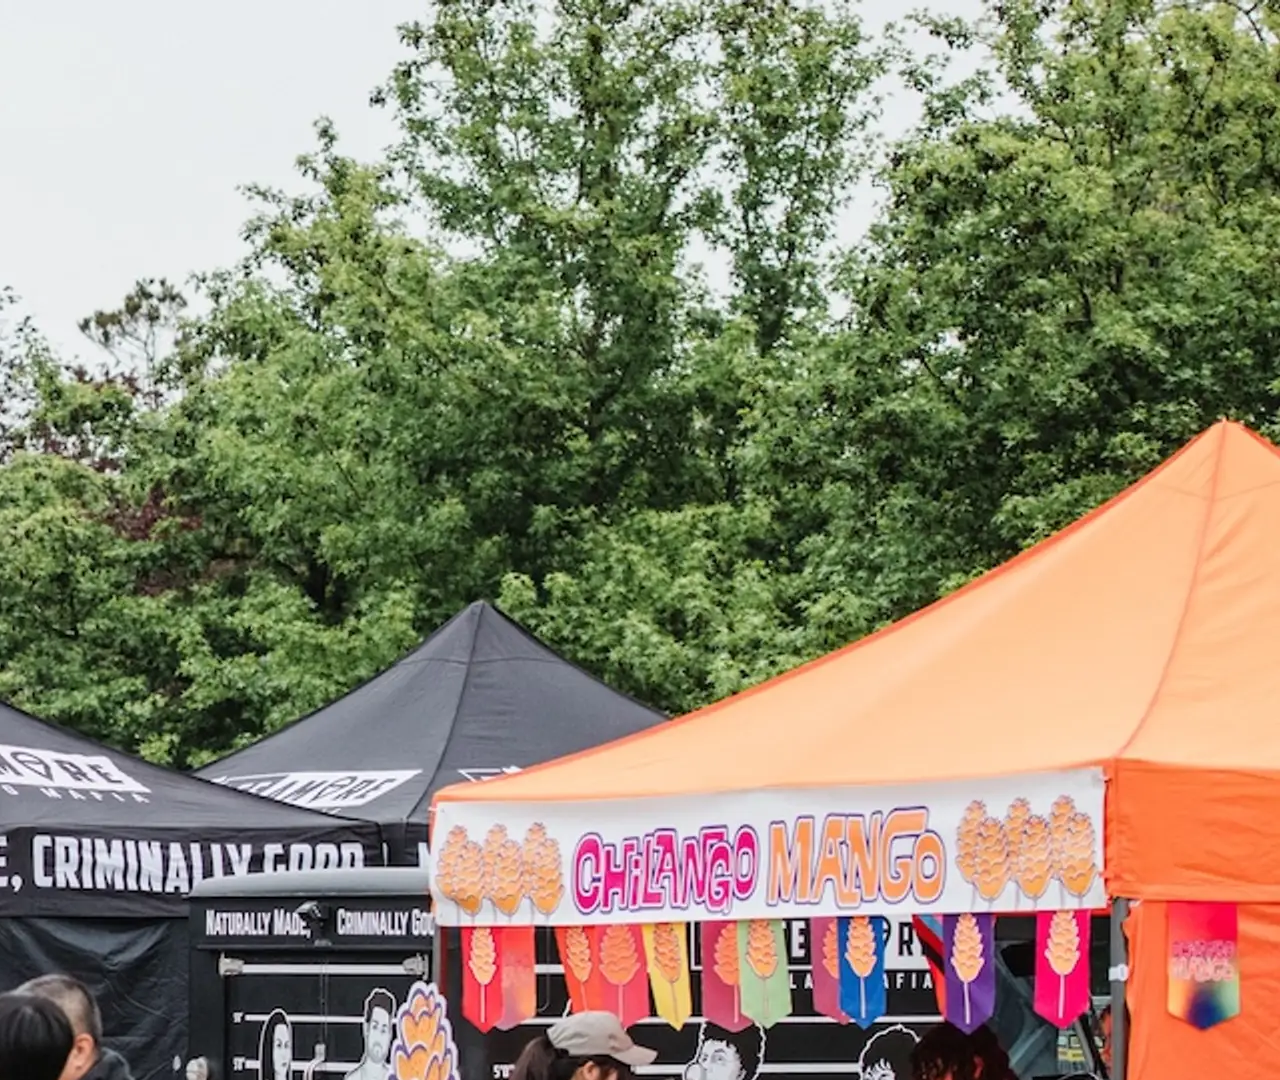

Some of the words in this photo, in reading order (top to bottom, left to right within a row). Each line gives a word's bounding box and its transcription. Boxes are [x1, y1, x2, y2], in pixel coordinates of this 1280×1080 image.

[42, 788, 150, 804] MAFIA
[32, 834, 252, 893] CRIMINALLY
[766, 806, 946, 908] MANGO
[206, 908, 271, 936] NATURALLY
[273, 908, 311, 938] MADE,
[337, 908, 410, 936] CRIMINALLY
